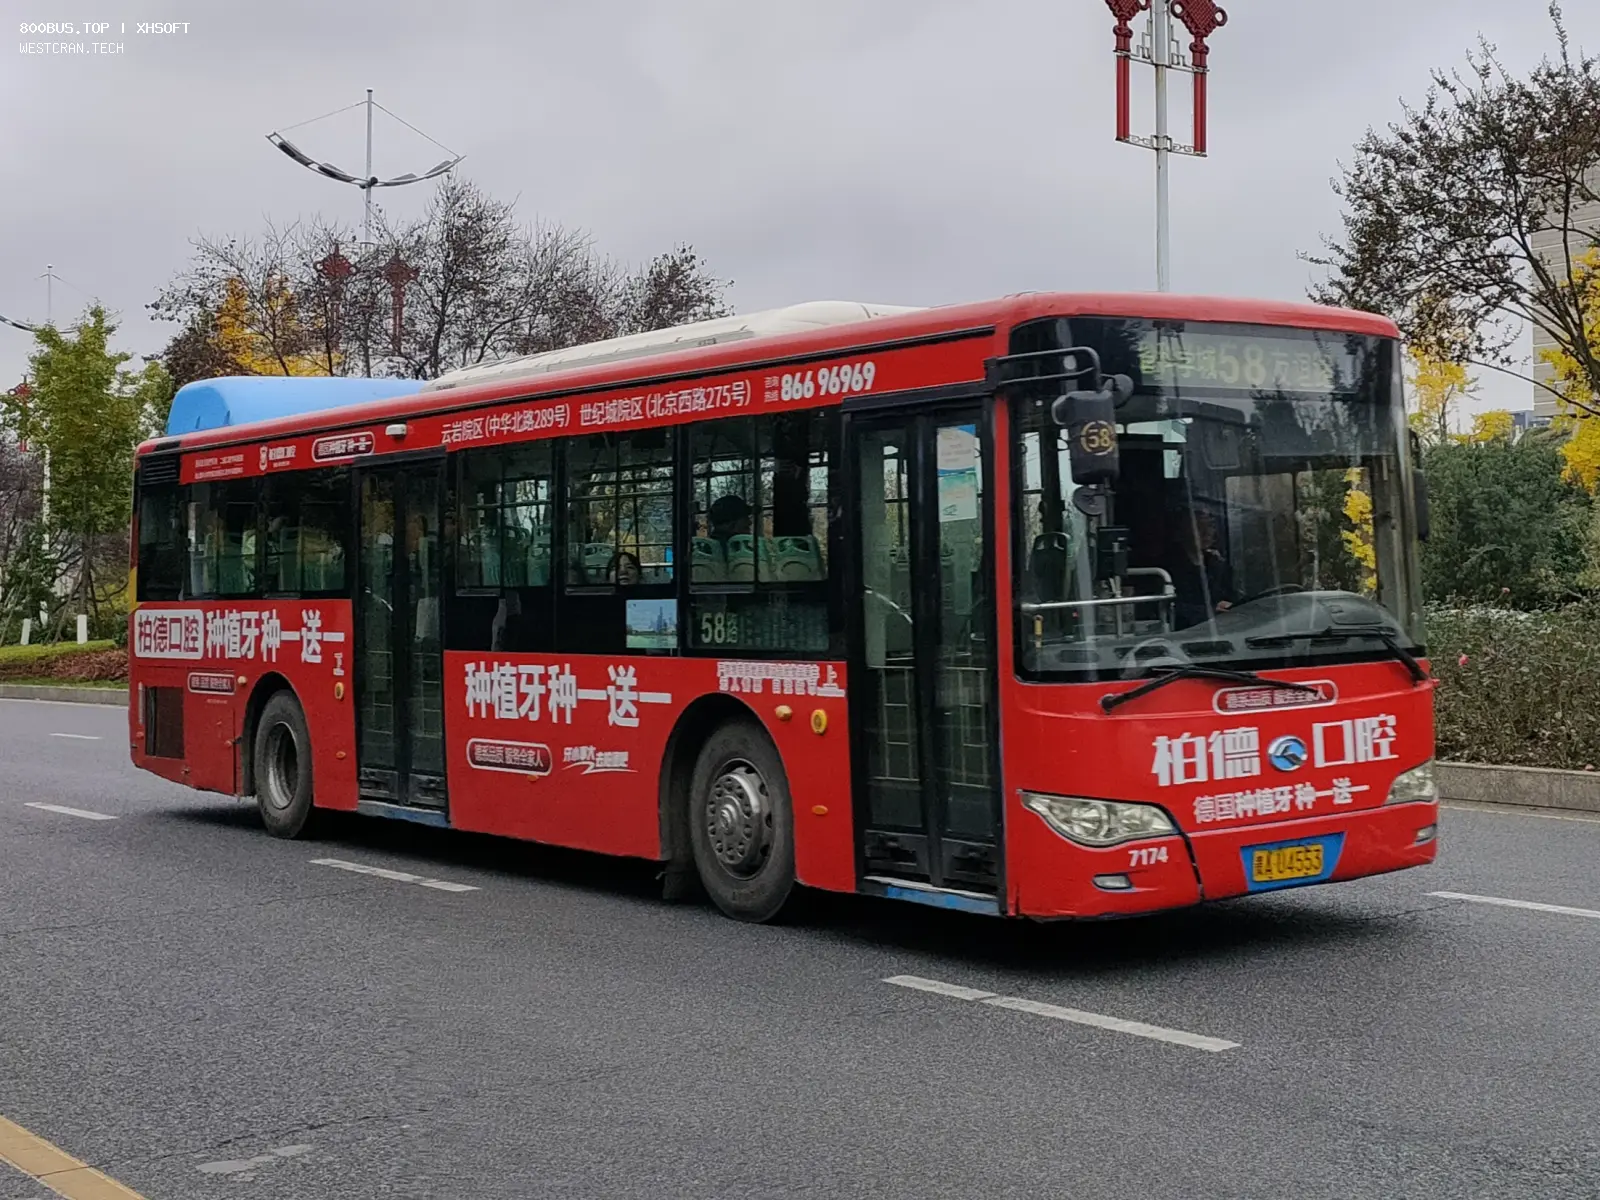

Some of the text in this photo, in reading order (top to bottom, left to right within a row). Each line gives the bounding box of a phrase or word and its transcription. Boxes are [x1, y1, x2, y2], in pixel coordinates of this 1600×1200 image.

[781, 361, 876, 401] 866 96969
[1218, 342, 1267, 386] 58
[1087, 428, 1111, 449] 58
[138, 608, 345, 663] 柏德口腔 种植牙种一送一
[464, 661, 672, 727] 种植牙种一送一
[1152, 713, 1399, 786] 柏德 口腔
[1127, 846, 1169, 867] 7174
